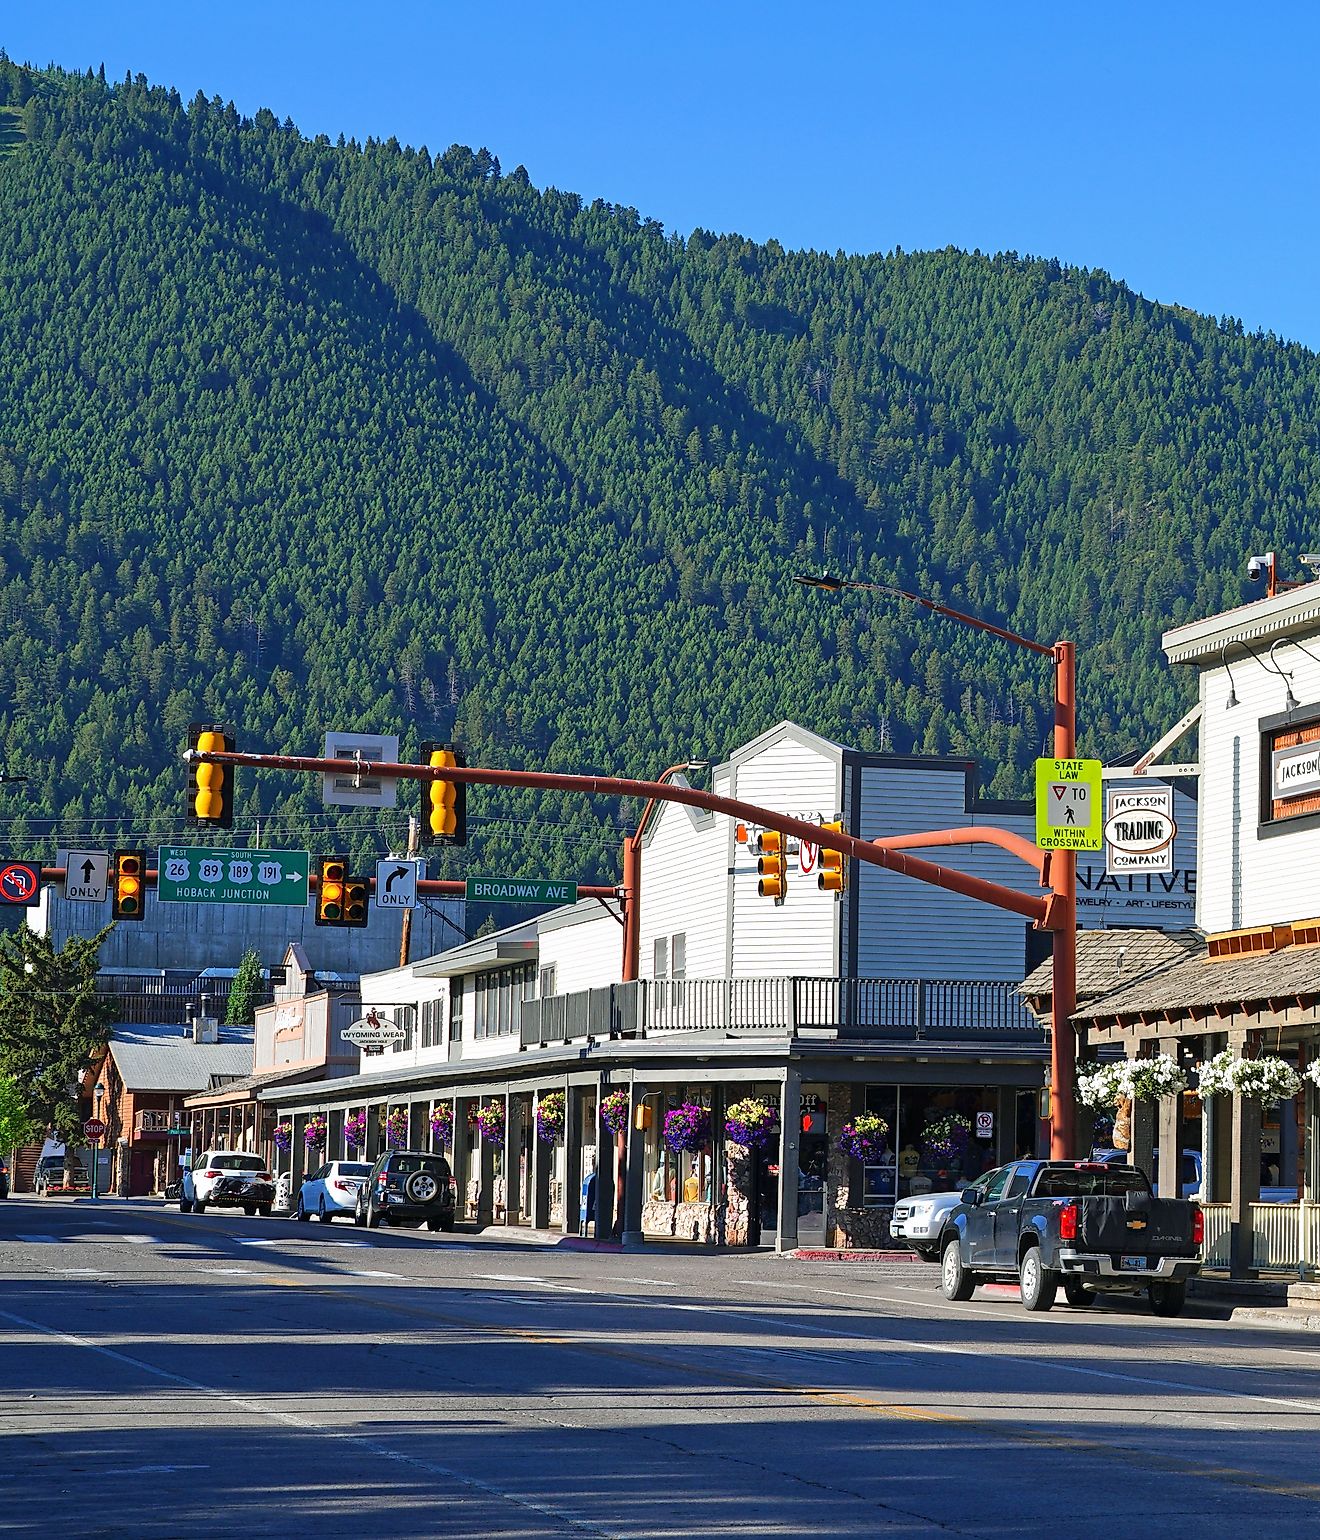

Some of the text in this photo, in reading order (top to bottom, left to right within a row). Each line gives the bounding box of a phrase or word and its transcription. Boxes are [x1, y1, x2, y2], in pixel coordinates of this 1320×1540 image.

[1054, 761, 1084, 771] STATE
[1282, 759, 1318, 782] JACKSON
[1059, 770, 1079, 780] LAW
[1072, 787, 1087, 801] TO
[1114, 796, 1167, 809] JACKSON
[1053, 829, 1086, 838] WITHIN
[1114, 820, 1164, 842] TRADING
[1040, 838, 1099, 848] CROSSWALK
[169, 849, 187, 857] WEST
[1113, 855, 1167, 866] COMPANY
[170, 863, 185, 876] 26
[203, 864, 219, 877] 89
[232, 865, 249, 878] 189
[263, 866, 277, 879] 191
[69, 886, 101, 898] ONLY
[176, 887, 270, 900] HOBACK JUNCTION
[474, 883, 569, 899] BROADWAY AVE
[382, 894, 411, 905] ONLY
[1075, 898, 1113, 908] EWELRY
[1125, 899, 1145, 909] ART
[342, 1031, 405, 1039] WYOMING WEAR
[85, 1124, 104, 1133] STOP
